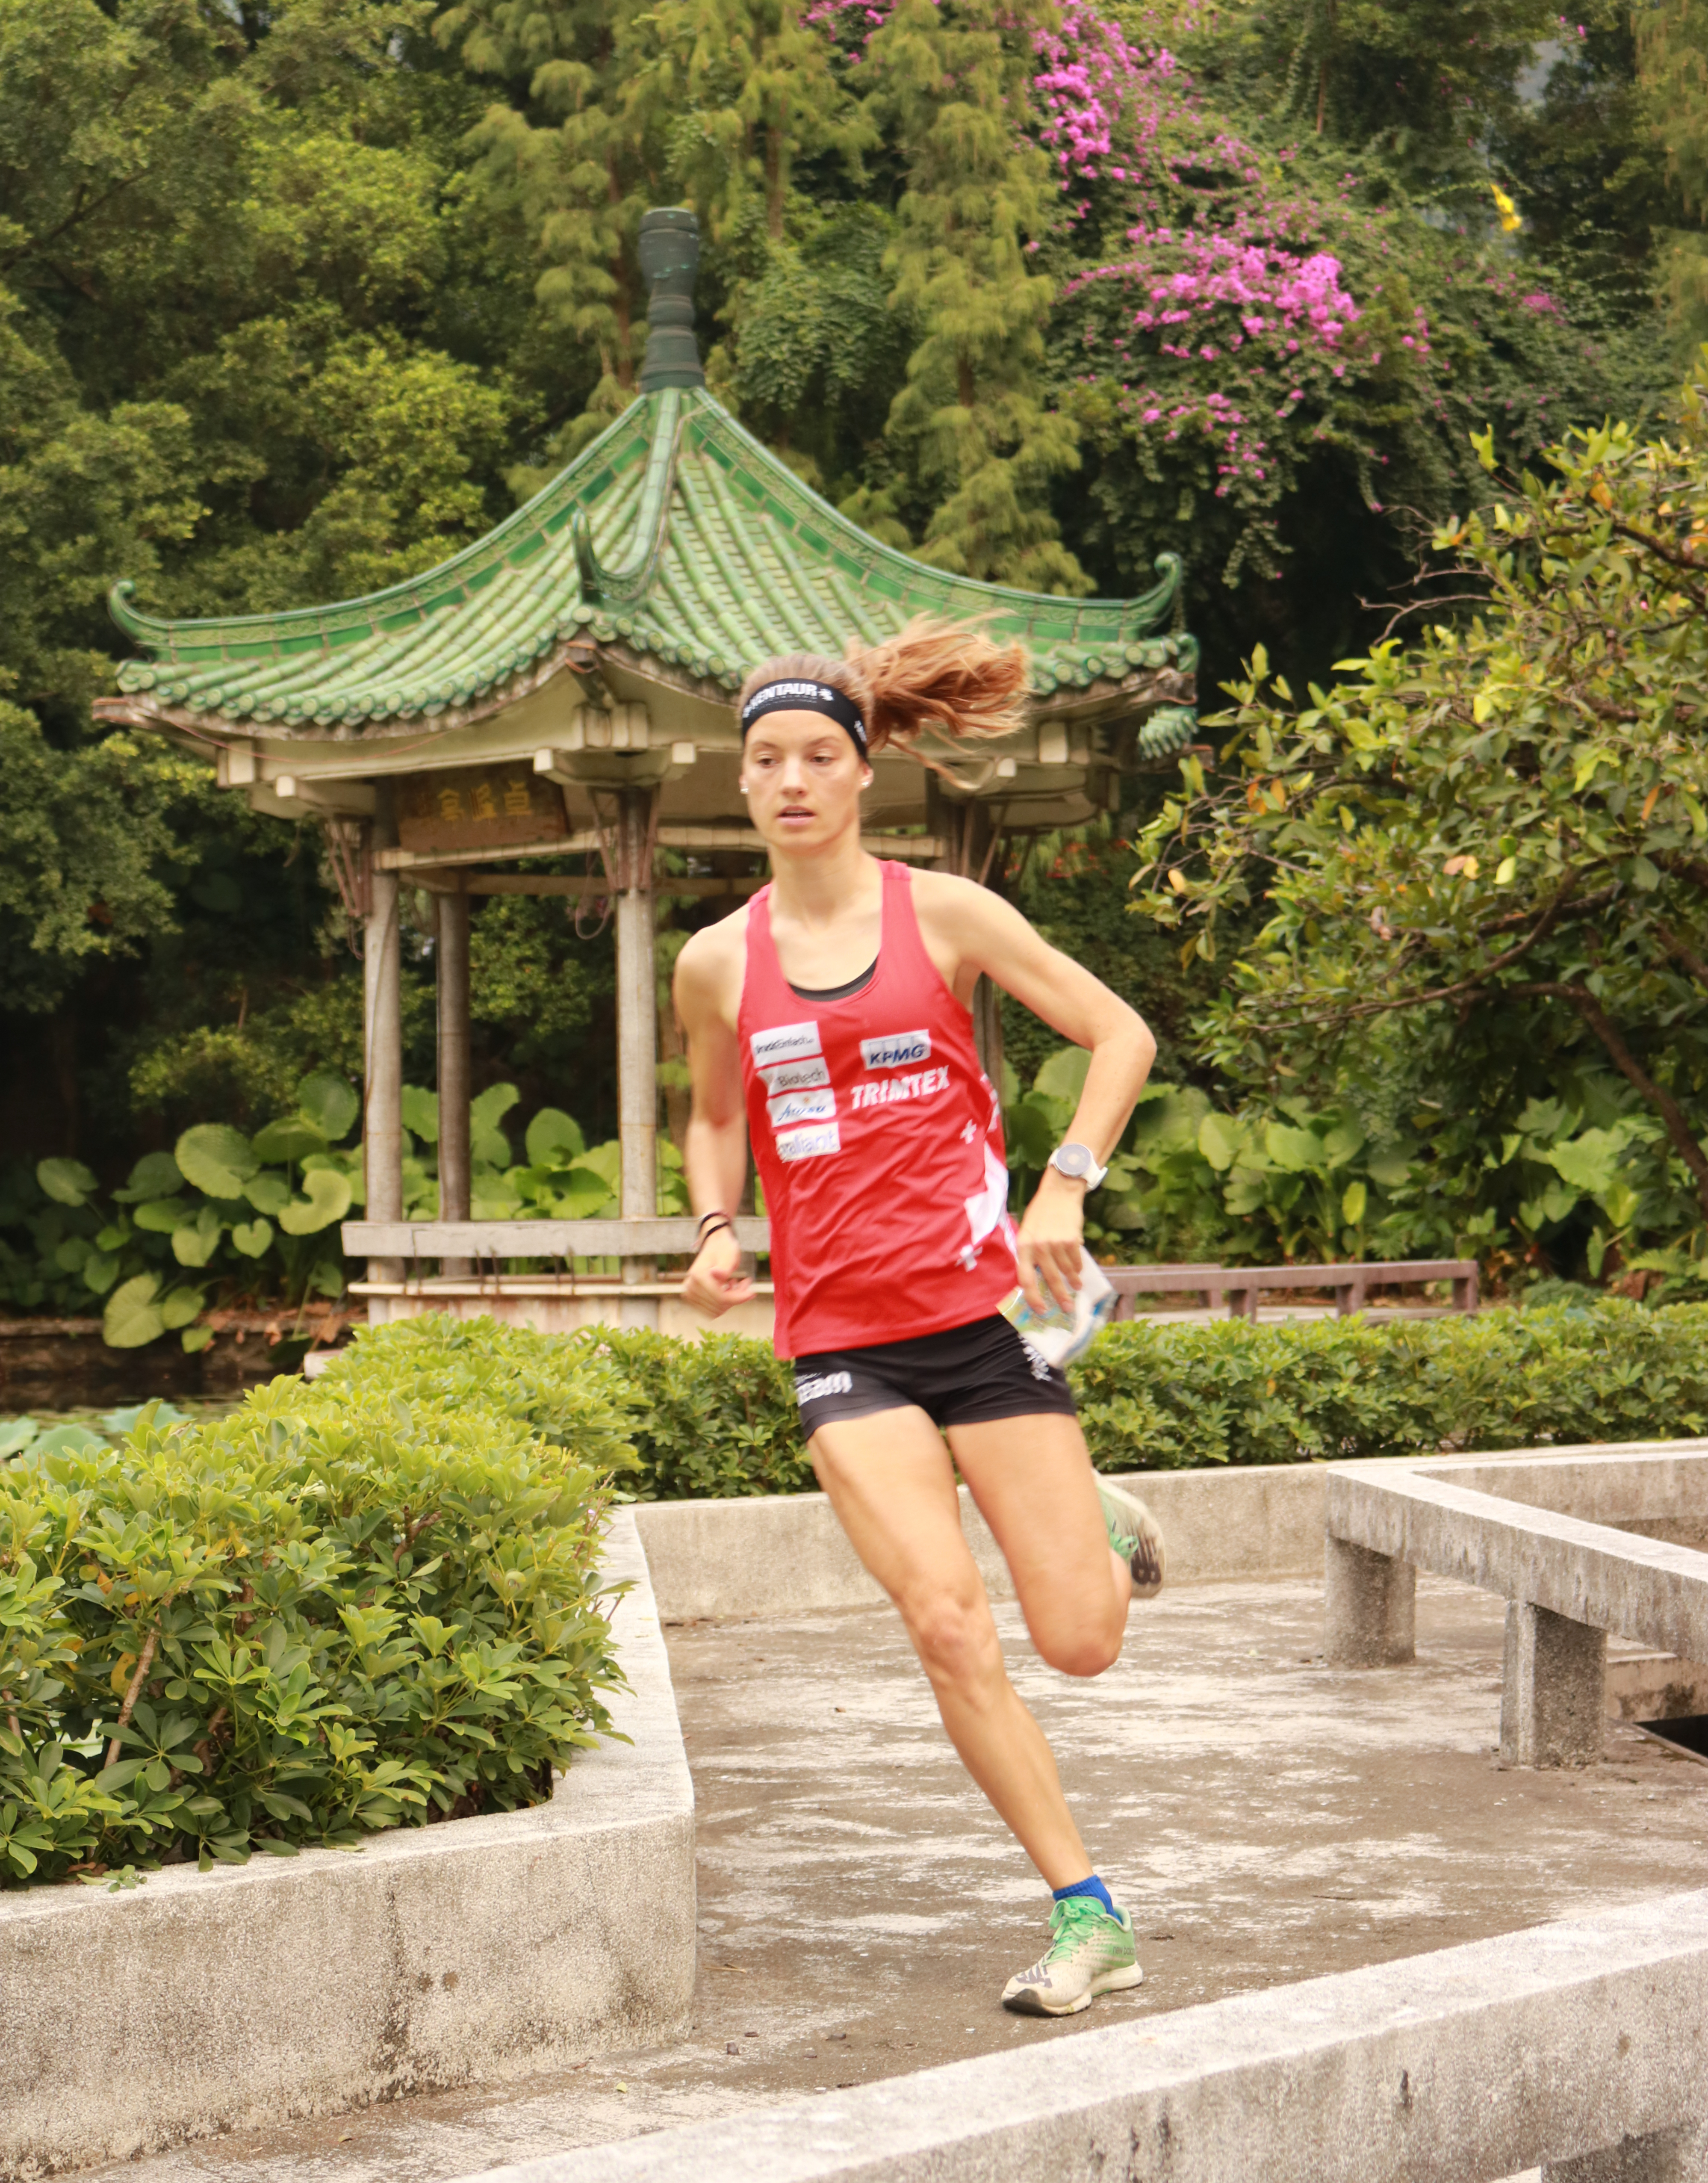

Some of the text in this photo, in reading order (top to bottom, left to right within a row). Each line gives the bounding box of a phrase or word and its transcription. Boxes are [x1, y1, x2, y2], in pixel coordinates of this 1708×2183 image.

[870, 1043, 925, 1065] KPMG
[777, 1068, 825, 1087] Biotech
[850, 1065, 950, 1110] TRIMTEX
[1112, 1946, 1123, 1955] new
